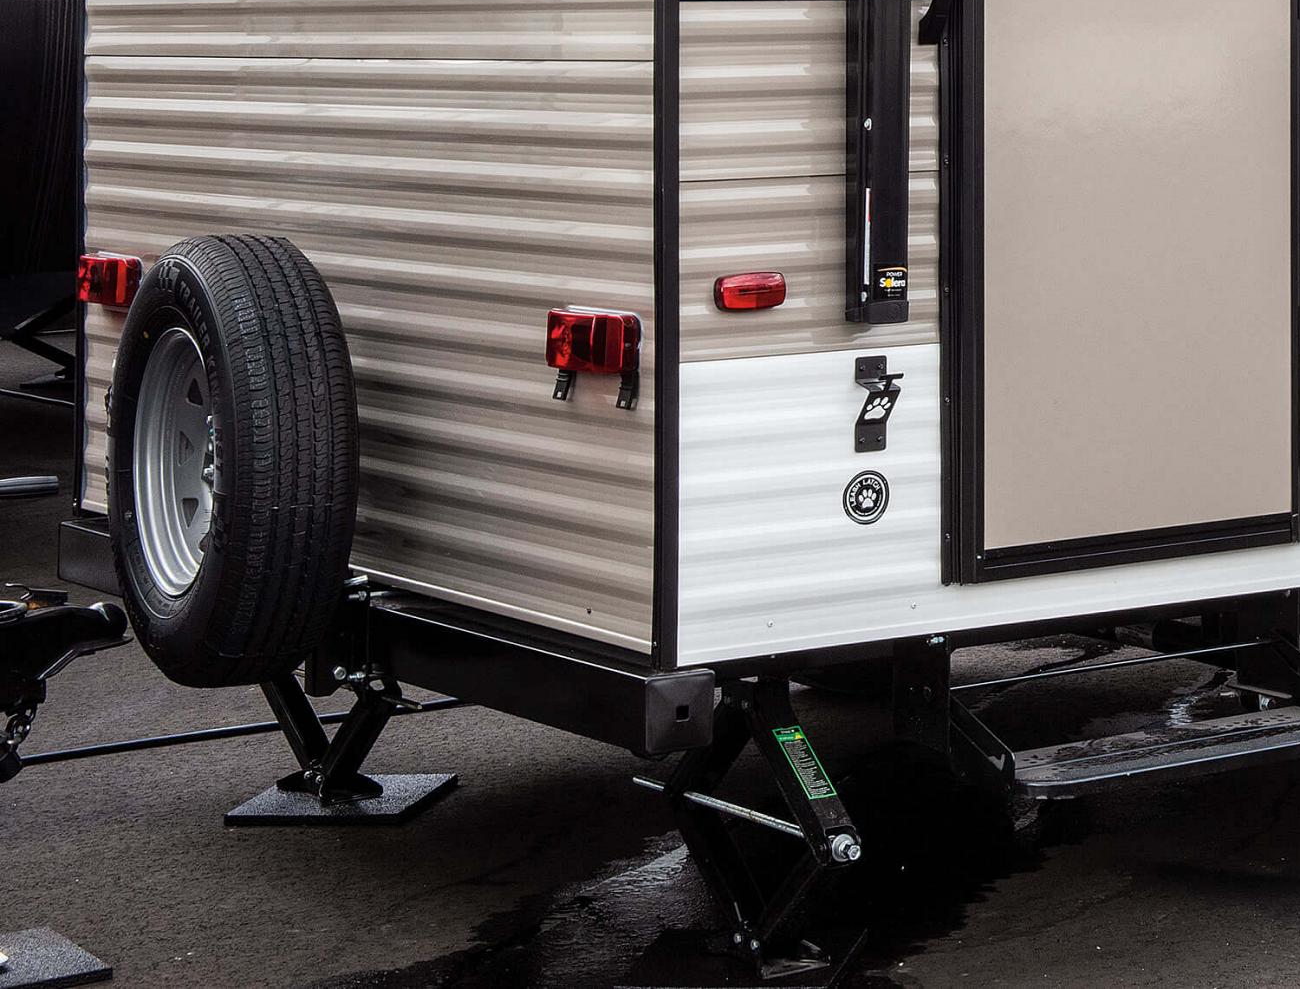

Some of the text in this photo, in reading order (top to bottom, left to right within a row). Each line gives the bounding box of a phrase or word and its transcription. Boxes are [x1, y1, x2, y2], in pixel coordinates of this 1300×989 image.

[178, 279, 211, 350] TRAILER
[849, 483, 861, 507] LEASH
[862, 477, 881, 492] LATCH
